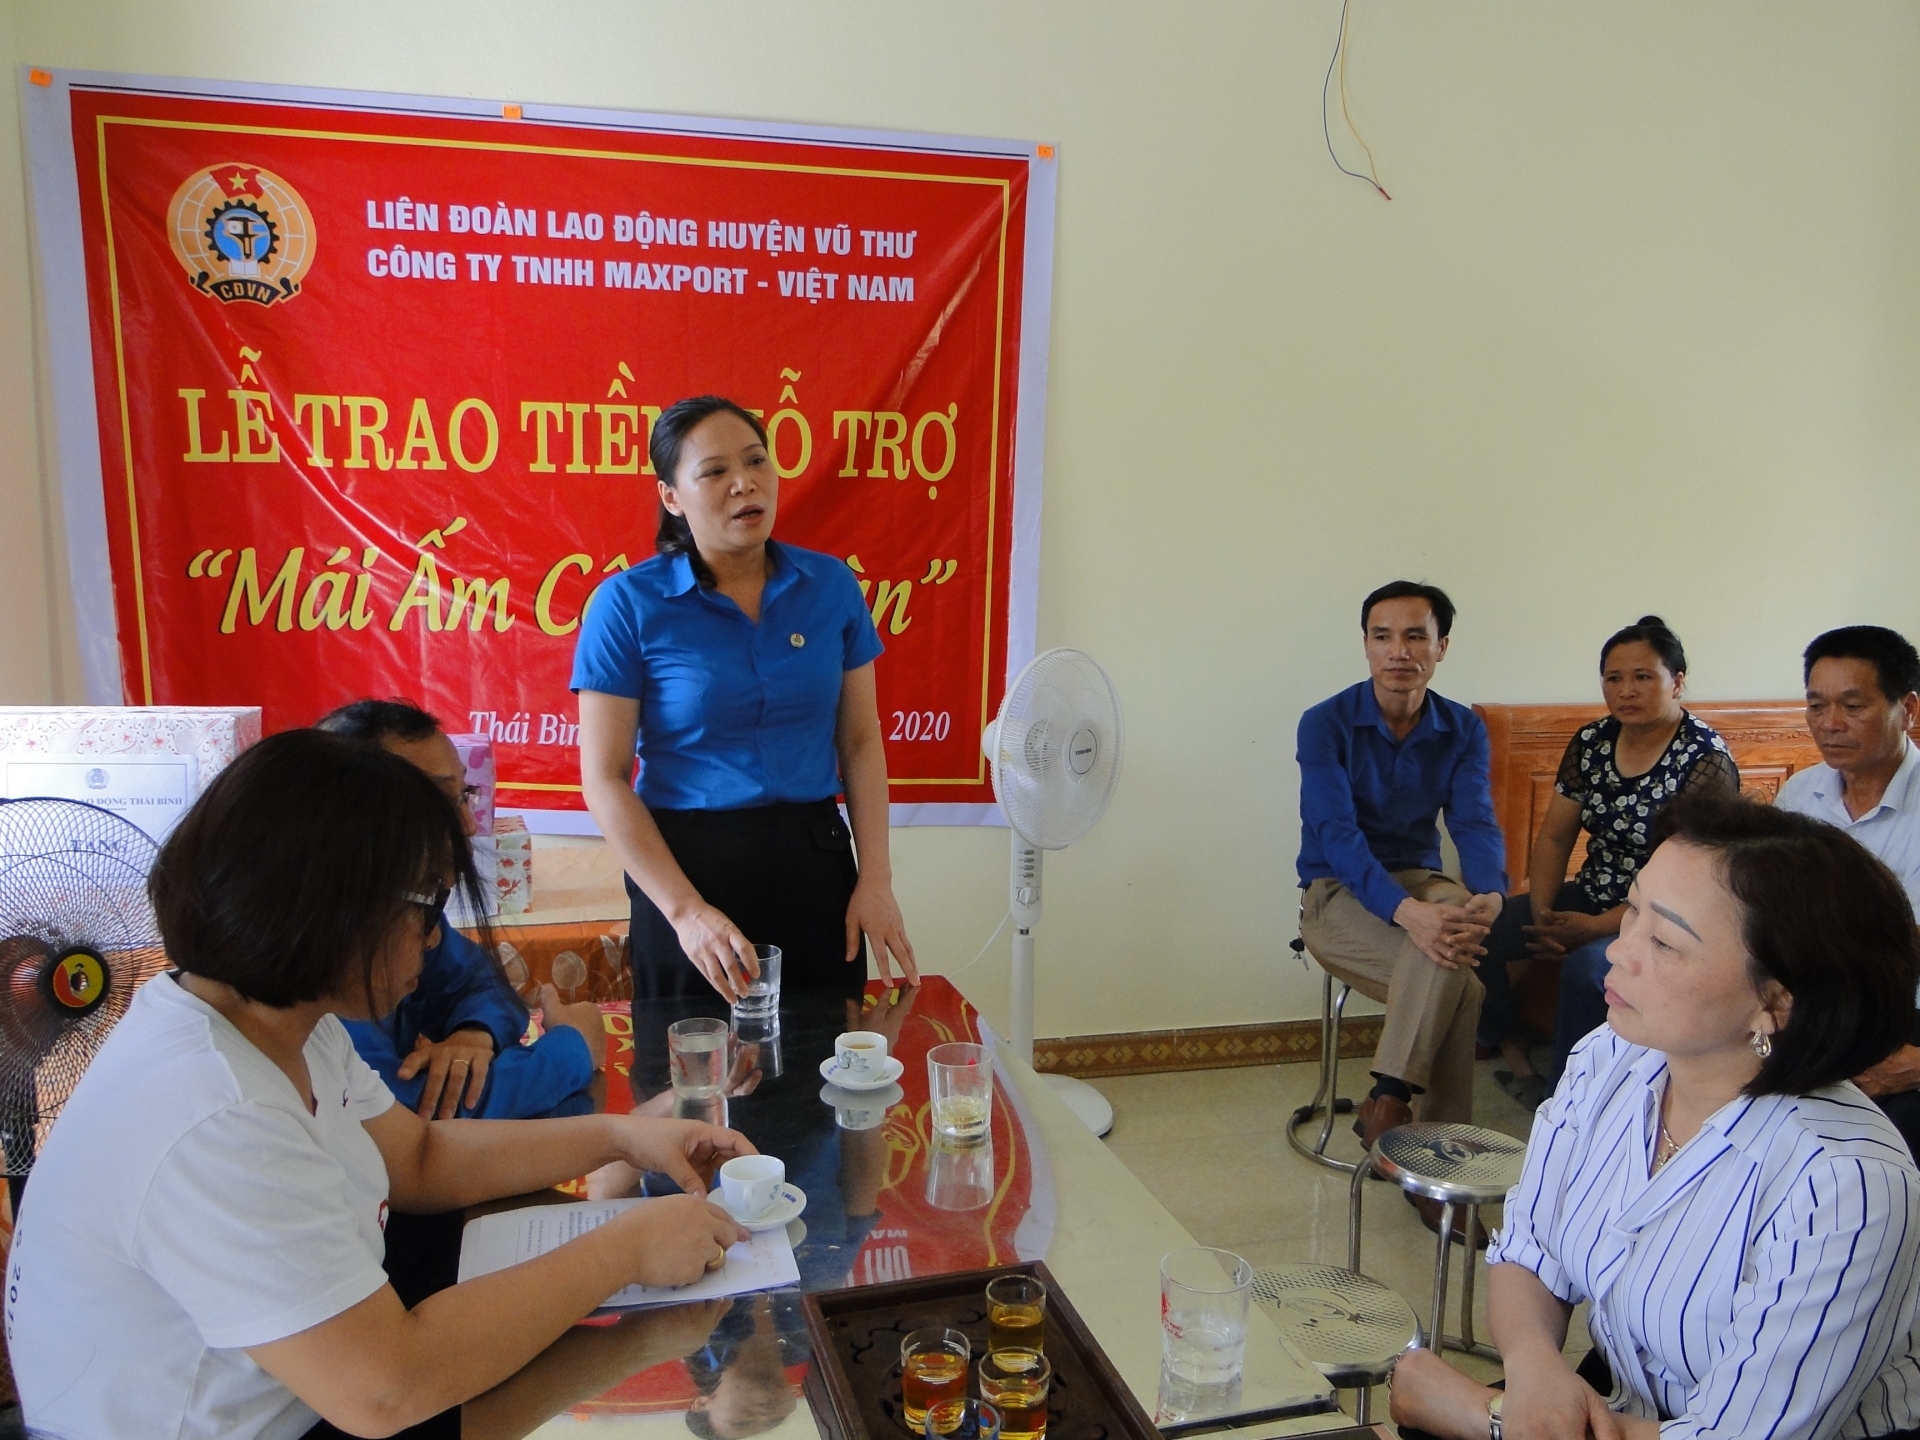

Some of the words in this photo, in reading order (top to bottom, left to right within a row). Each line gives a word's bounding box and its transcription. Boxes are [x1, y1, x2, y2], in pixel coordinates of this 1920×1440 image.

[367, 196, 439, 232] LIÊN
[449, 201, 537, 237] ĐOÀN
[547, 210, 604, 241] LAO
[614, 211, 698, 250] ĐỘNG
[708, 219, 805, 257] HUYỆN
[814, 224, 851, 256] VŨ
[860, 230, 918, 259] THƯ
[367, 244, 457, 281] CÔNG
[465, 253, 503, 282] TY
[511, 255, 594, 287] TNHH
[604, 261, 749, 295] MAXPORT
[777, 267, 839, 305] VIỆT
[848, 274, 915, 302] NAM
[178, 346, 281, 463] LỄ
[294, 393, 499, 473] TRAO
[520, 361, 662, 475] TIỀ
[746, 367, 813, 479] Ỗ
[833, 402, 958, 500] TRỢ
[388, 516, 516, 633] Ấm
[468, 711, 531, 744] Thái
[888, 710, 951, 742] 2020
